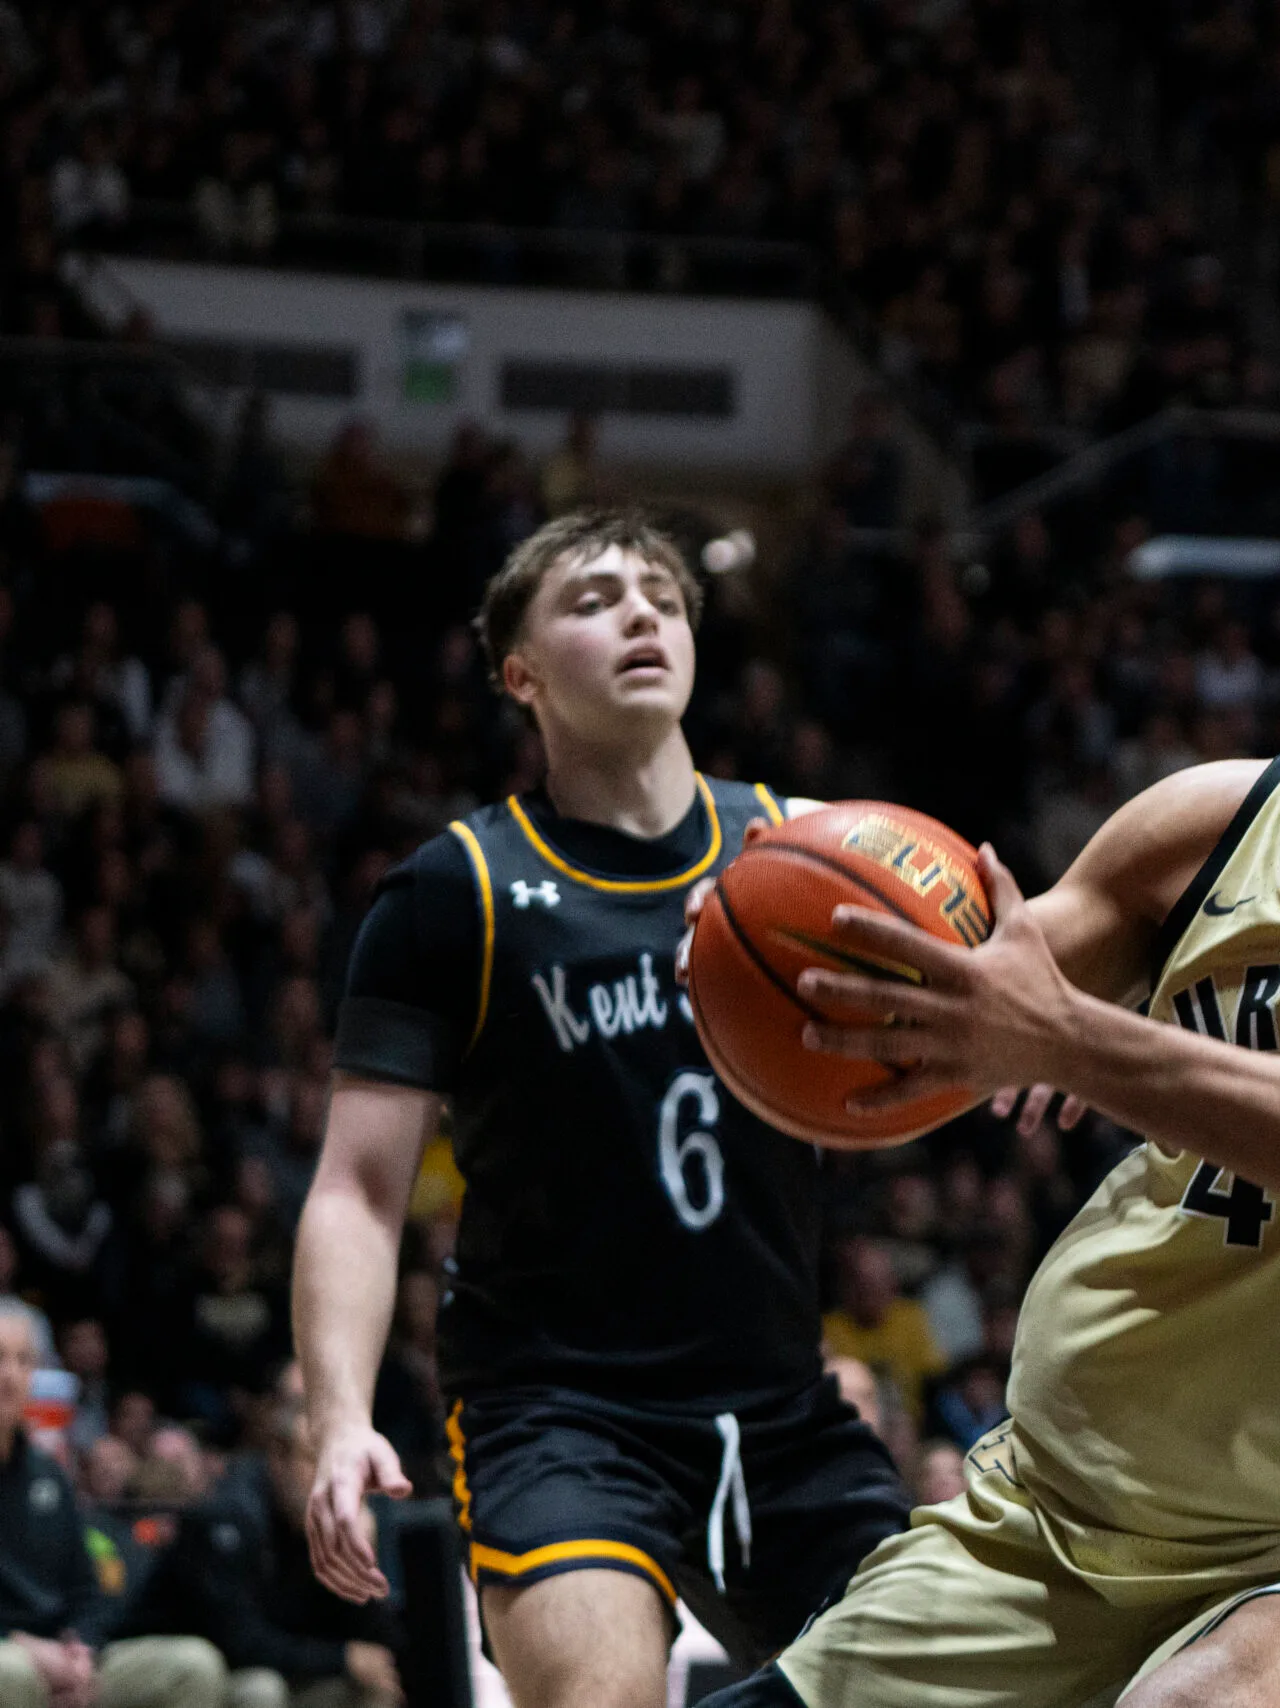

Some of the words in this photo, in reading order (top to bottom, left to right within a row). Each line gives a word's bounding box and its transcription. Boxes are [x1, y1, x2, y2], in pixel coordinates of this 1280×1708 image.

[530, 951, 668, 1053] Kent
[659, 1070, 726, 1231] 6
[1178, 1157, 1277, 1250] 4
